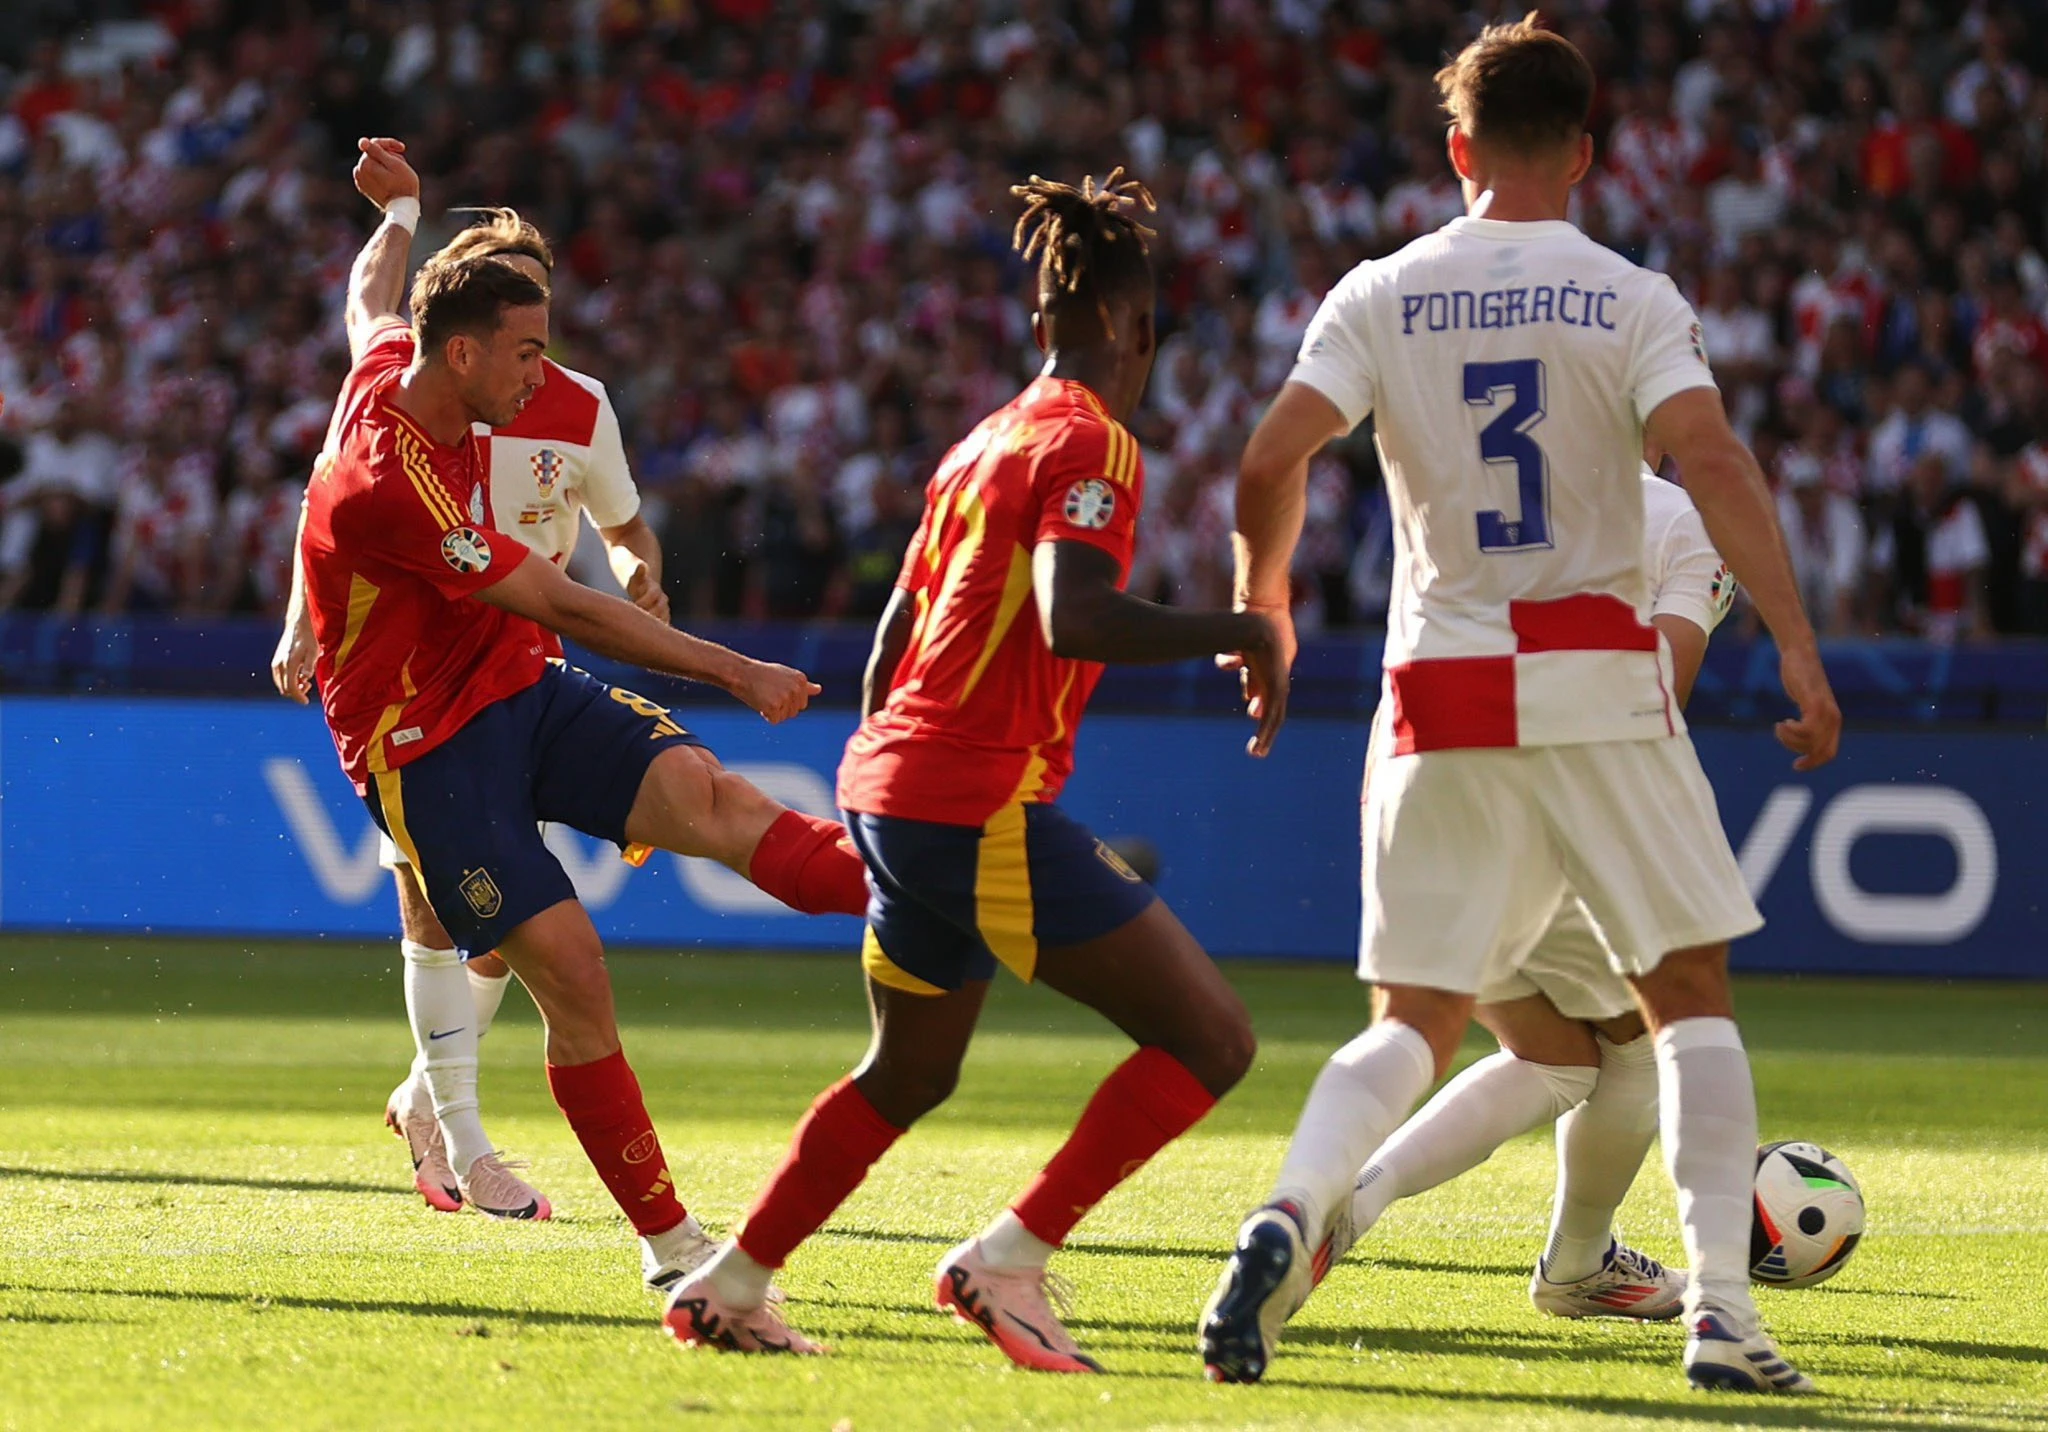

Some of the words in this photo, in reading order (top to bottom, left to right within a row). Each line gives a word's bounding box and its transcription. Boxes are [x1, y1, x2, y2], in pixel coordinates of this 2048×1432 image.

[1402, 279, 1617, 335] PONGRAČIĆ
[1463, 357, 1555, 554] 3
[609, 686, 668, 717] 8
